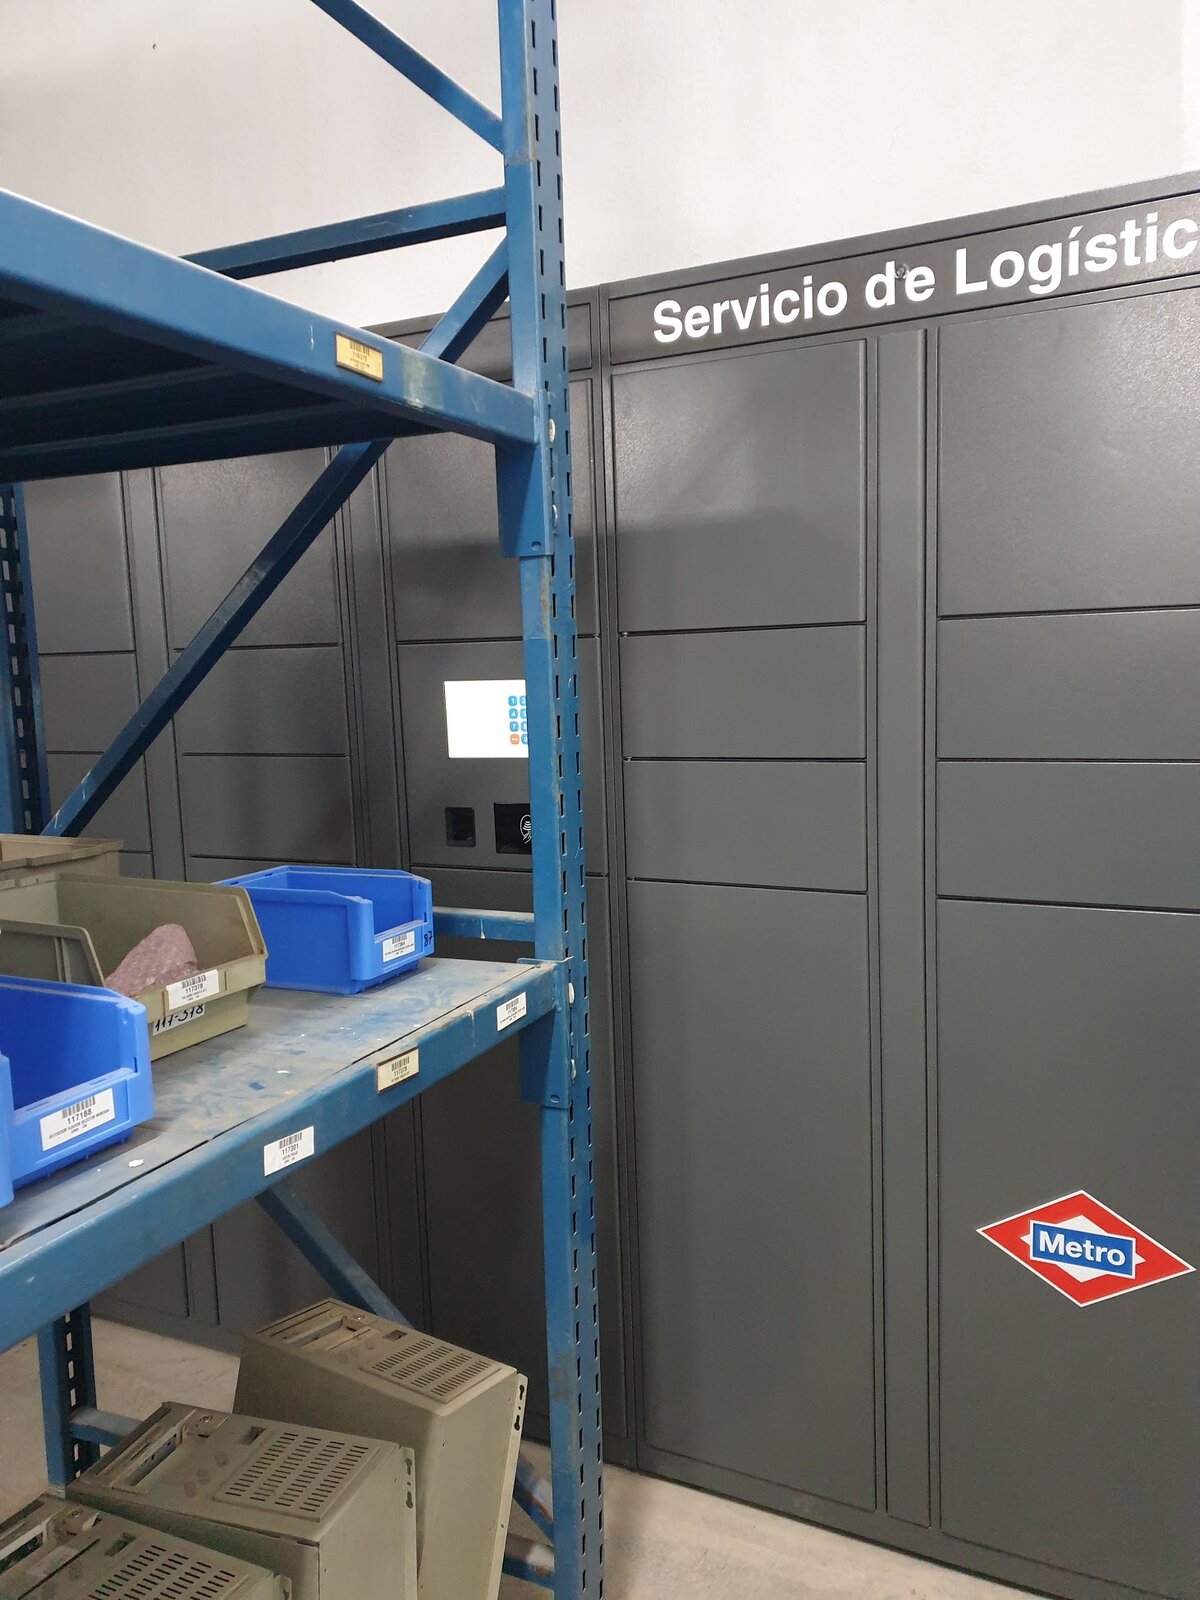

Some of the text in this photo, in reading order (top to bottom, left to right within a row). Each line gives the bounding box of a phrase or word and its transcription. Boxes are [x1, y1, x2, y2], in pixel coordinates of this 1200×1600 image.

[653, 211, 1199, 344] Servicio de Logístic
[67, 1107, 93, 1125] 117188
[1039, 1230, 1126, 1266] Metro
